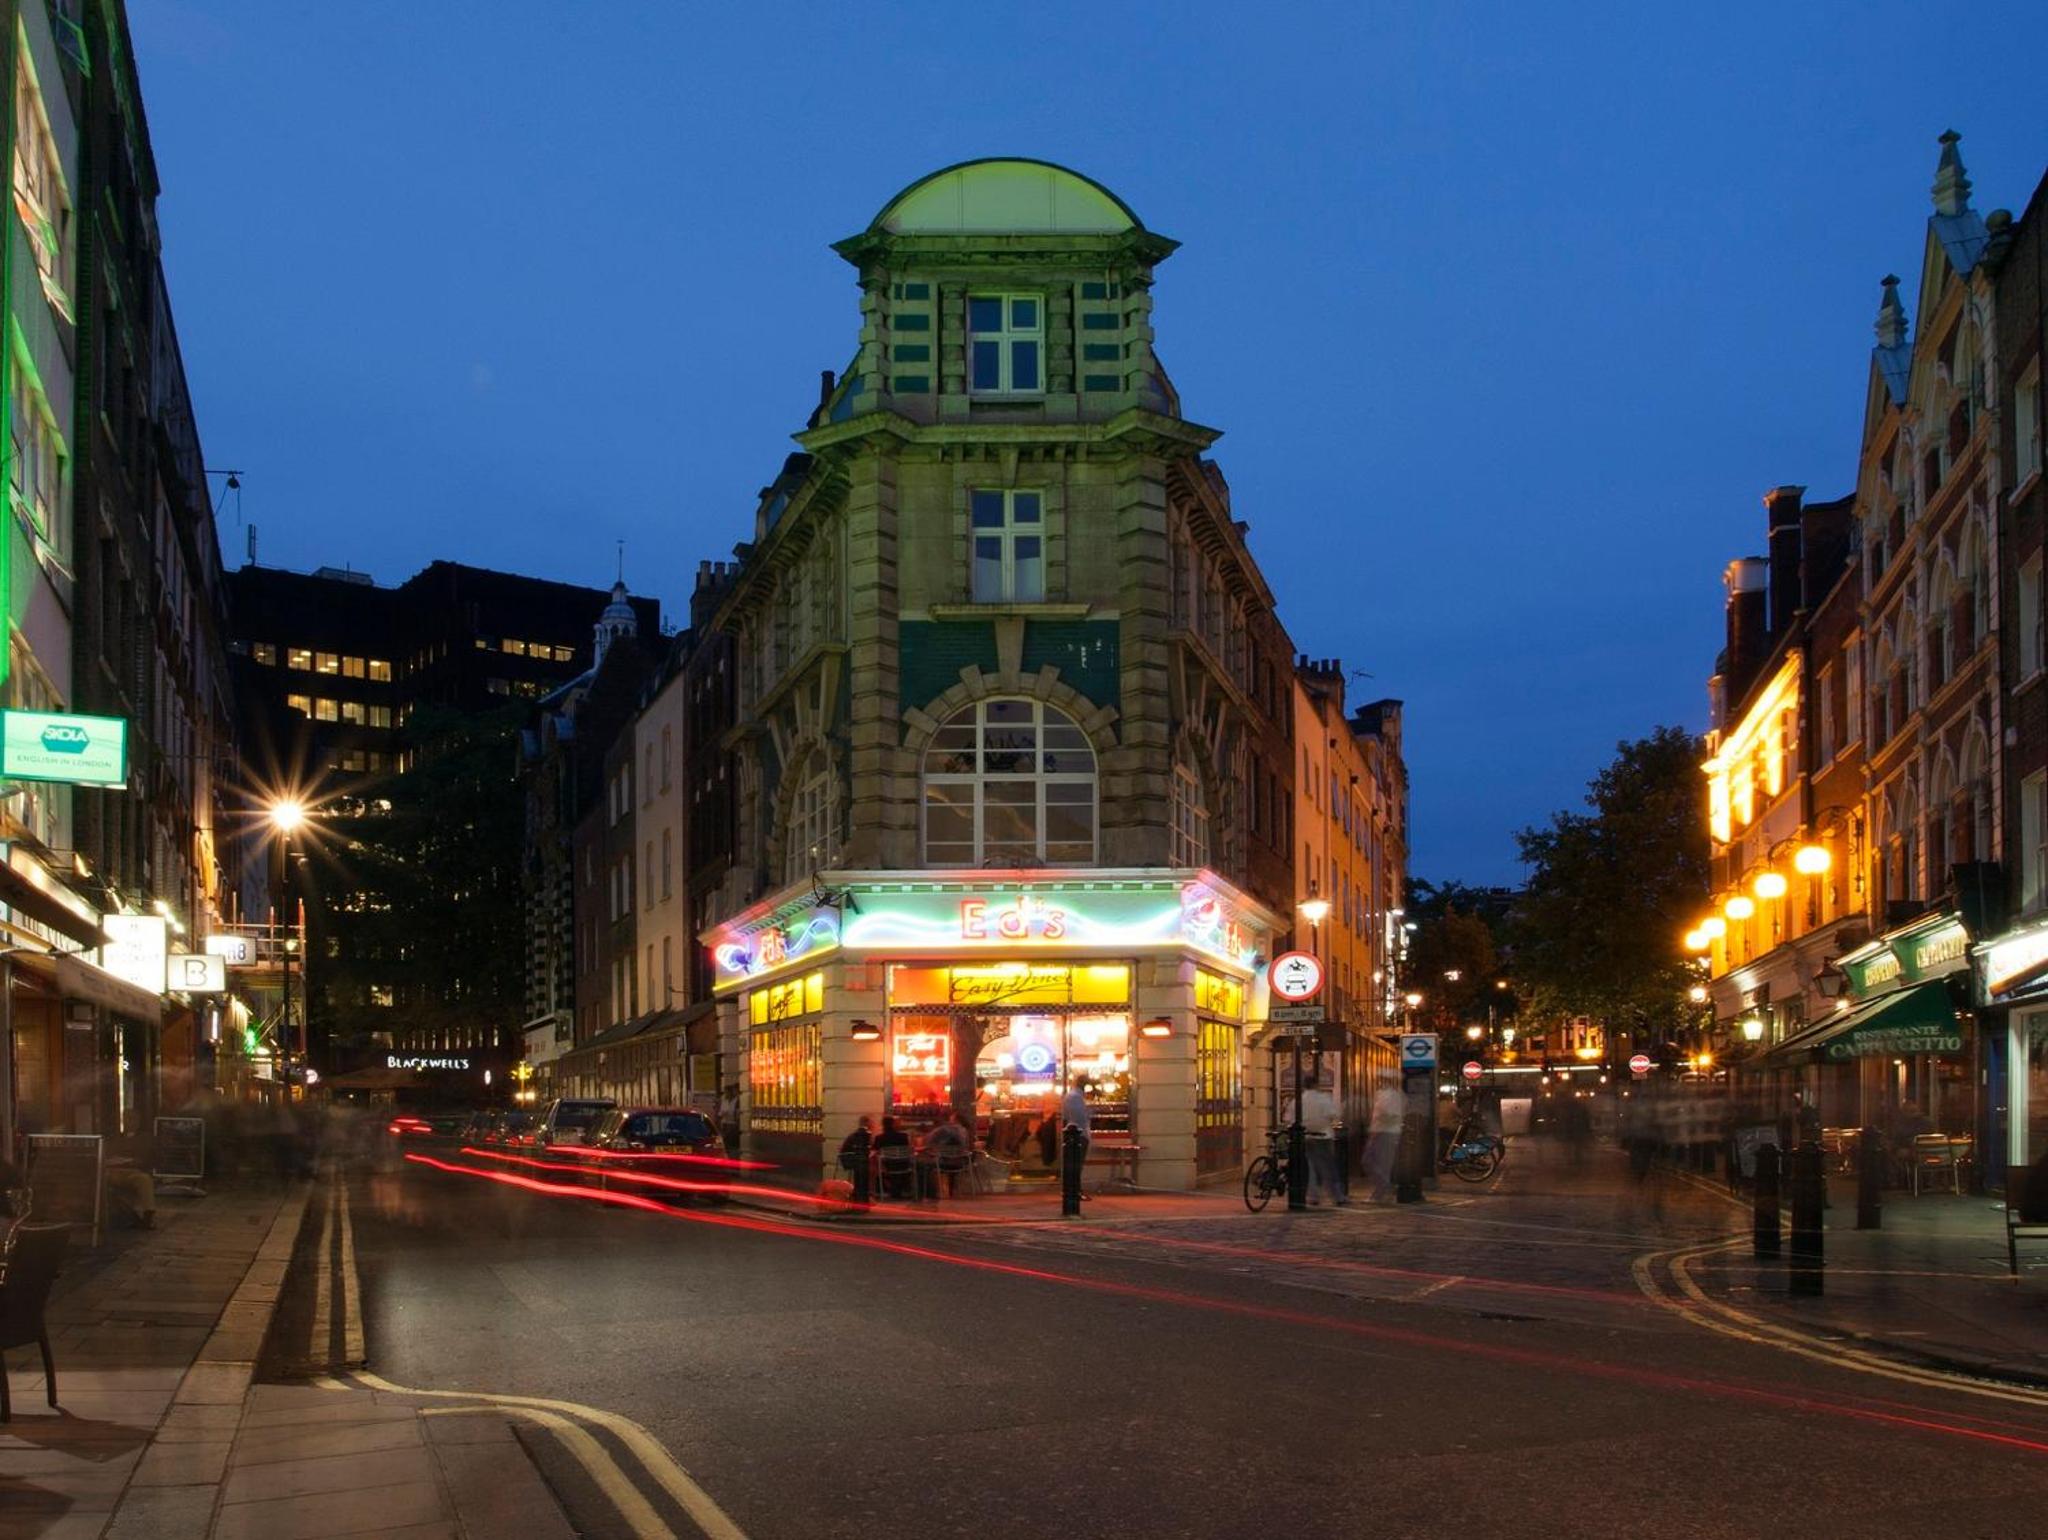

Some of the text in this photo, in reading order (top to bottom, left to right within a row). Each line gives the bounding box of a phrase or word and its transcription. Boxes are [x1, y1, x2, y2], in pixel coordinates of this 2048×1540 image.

[44, 727, 87, 741] SKOLA
[17, 754, 112, 768] ENGLISH IN LONDON
[960, 895, 1065, 939] Ed's
